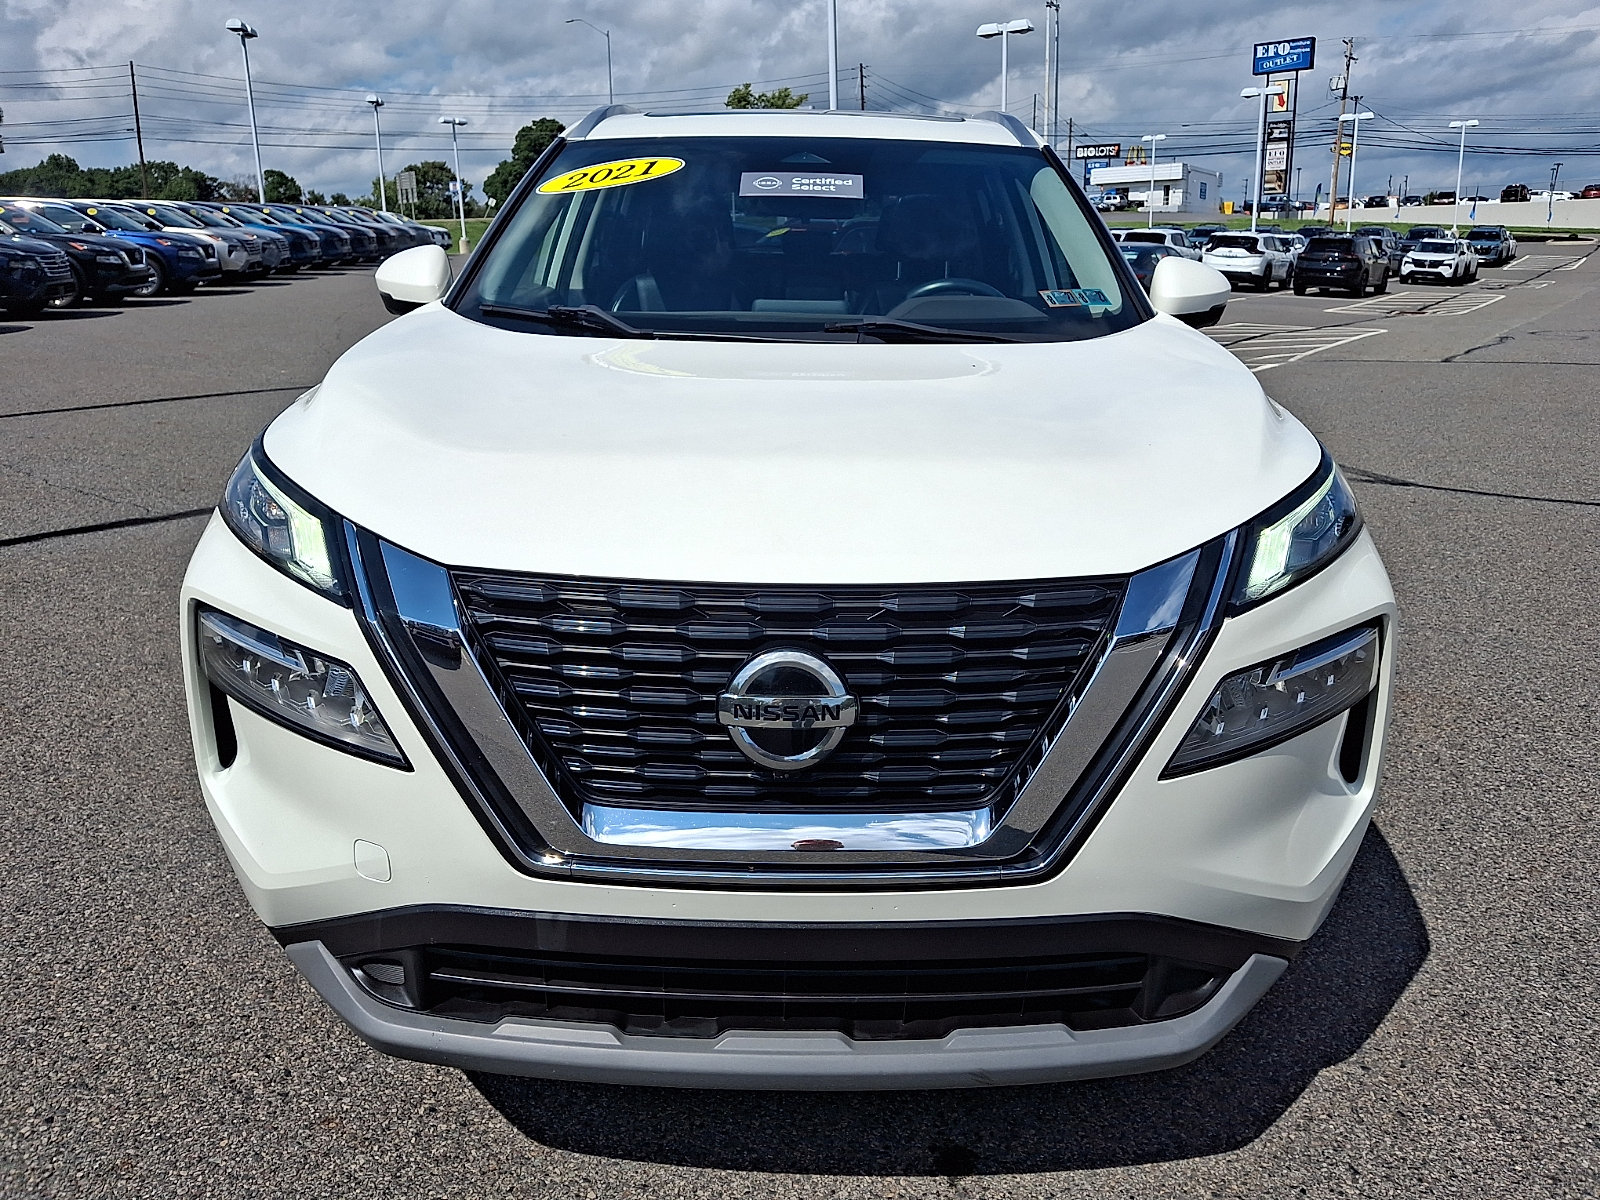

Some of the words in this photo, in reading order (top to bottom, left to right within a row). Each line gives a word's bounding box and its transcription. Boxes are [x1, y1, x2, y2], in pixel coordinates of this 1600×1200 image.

[1256, 43, 1290, 58] EFO
[1263, 55, 1298, 68] OUTLET
[562, 160, 658, 189] 2021
[733, 704, 841, 722] NISSAN
